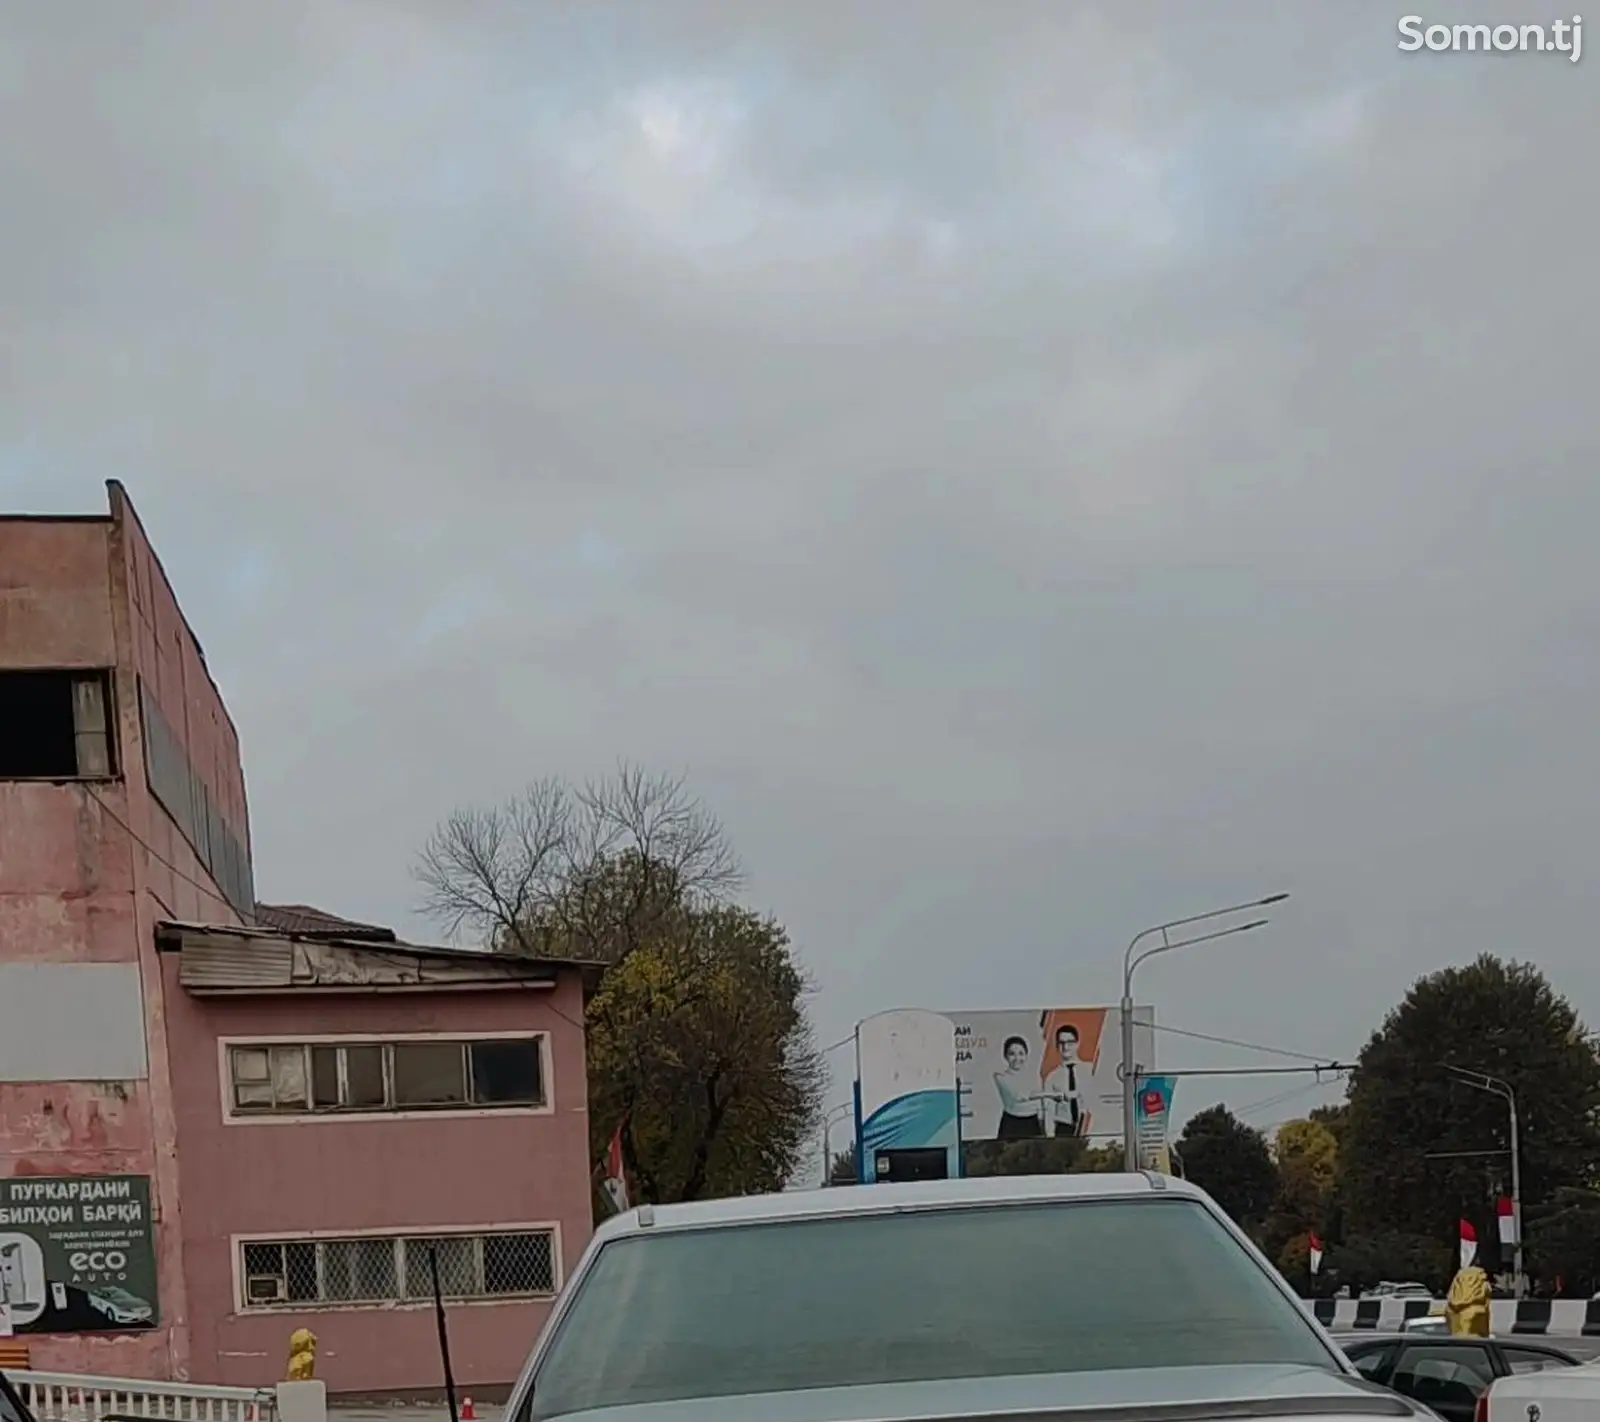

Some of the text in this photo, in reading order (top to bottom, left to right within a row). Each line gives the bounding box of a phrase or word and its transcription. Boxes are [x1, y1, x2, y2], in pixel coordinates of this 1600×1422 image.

[10, 1180, 130, 1201] ПУРКАРДАНИ
[69, 1251, 126, 1271] eco
[72, 1272, 127, 1283] AUTO
